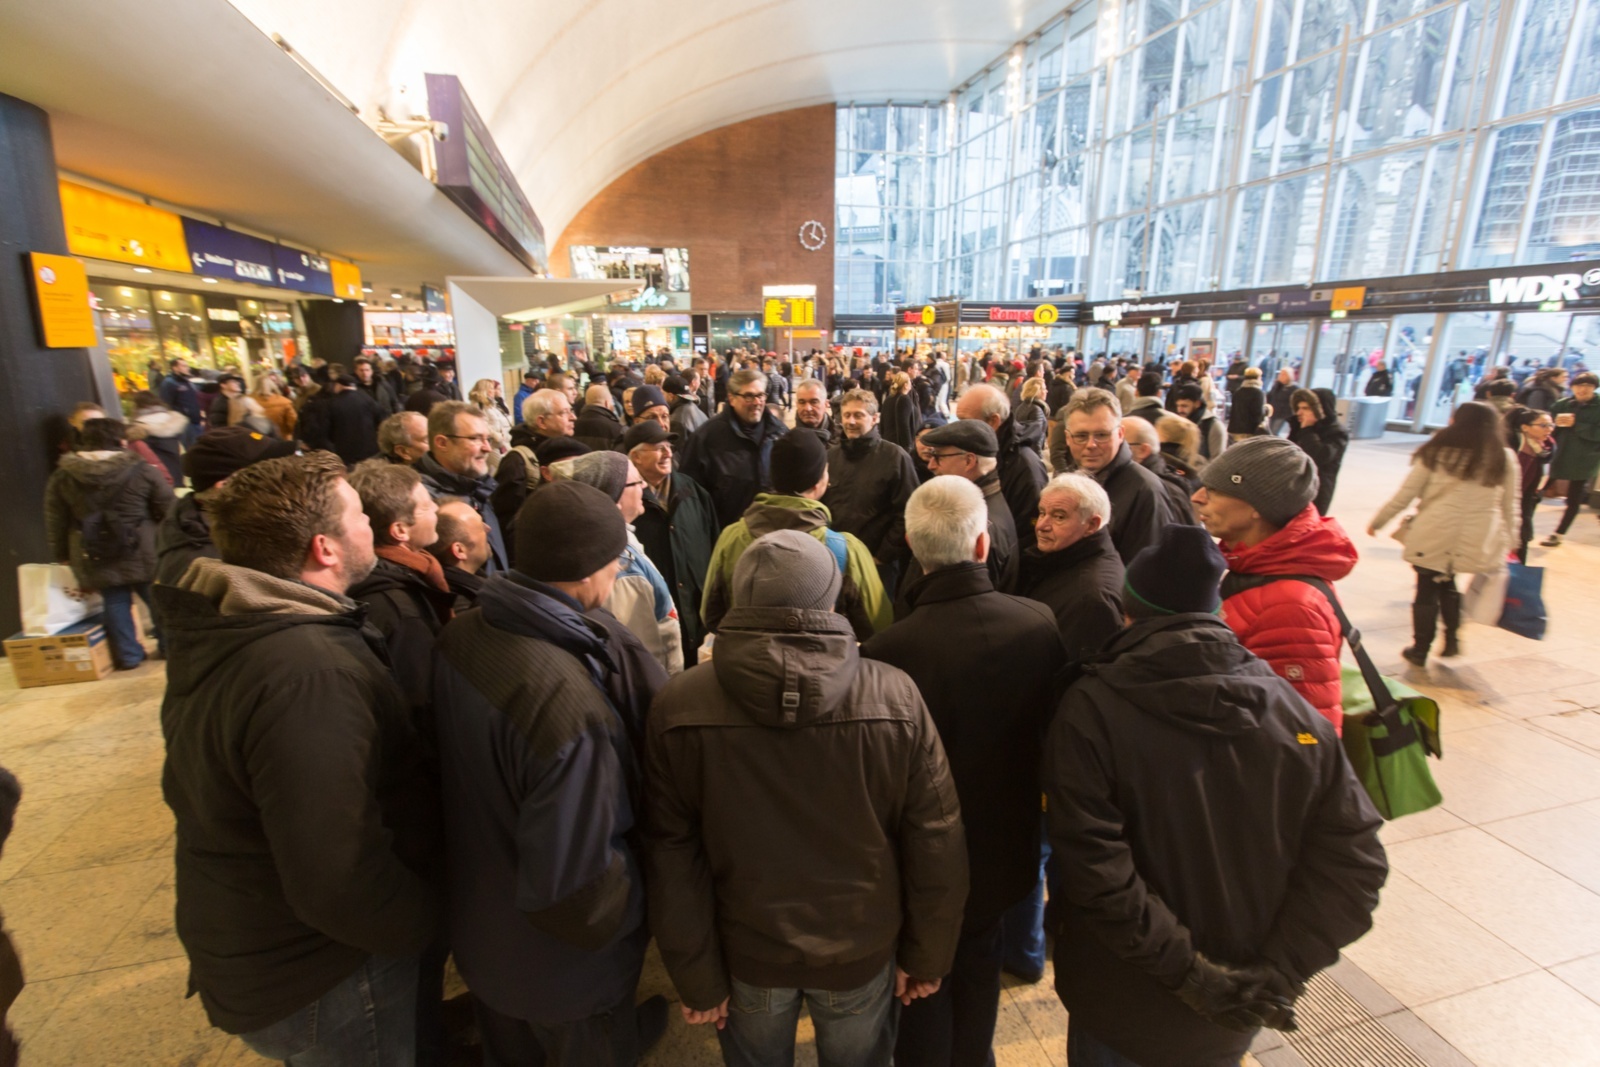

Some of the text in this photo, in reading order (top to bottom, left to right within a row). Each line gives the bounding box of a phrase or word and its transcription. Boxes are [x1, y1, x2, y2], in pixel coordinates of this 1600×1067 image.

[1488, 273, 1582, 304] WDR
[989, 306, 1033, 323] Kamps
[1093, 304, 1122, 321] WDR
[744, 320, 756, 331] U
